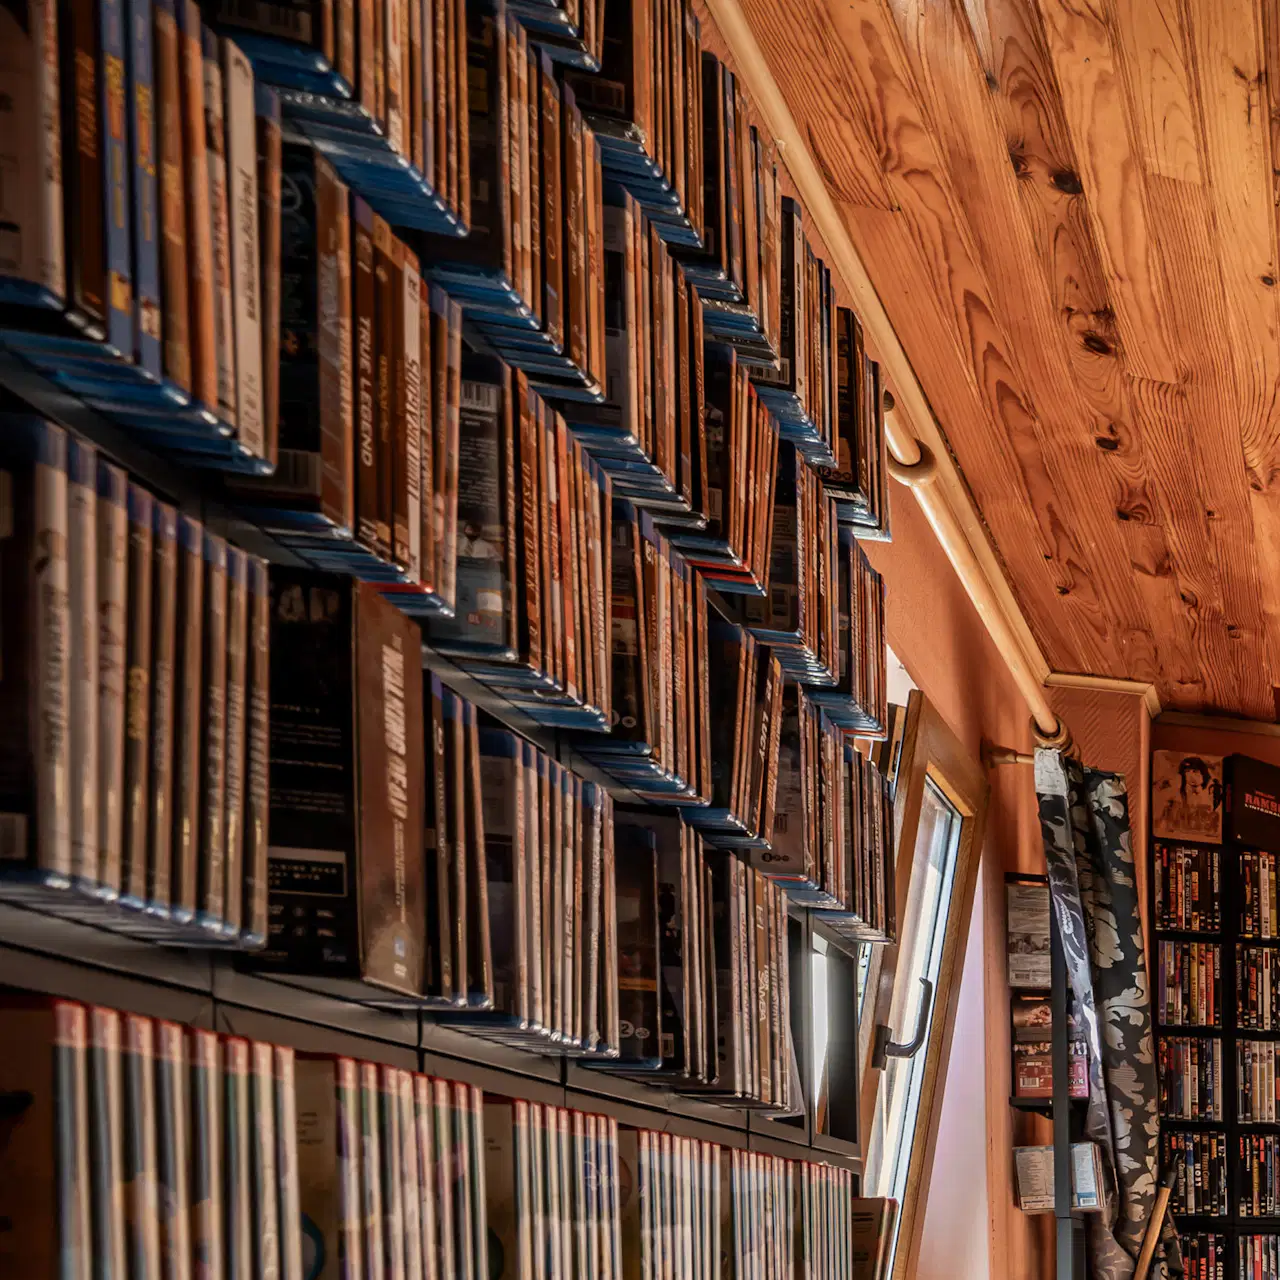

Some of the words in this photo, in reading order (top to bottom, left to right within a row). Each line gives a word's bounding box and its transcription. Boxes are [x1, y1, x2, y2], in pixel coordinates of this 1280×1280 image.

[530, 103, 540, 257] OBLIVION
[359, 316, 372, 374] TRUE
[359, 376, 373, 468] LEGEND
[521, 462, 533, 533] UPSIDE
[524, 537, 535, 593] DOWN
[382, 645, 406, 756] WALKING
[759, 711, 768, 763] LUCY
[387, 754, 407, 820] DEAD
[758, 970, 766, 1022] SAMBA
